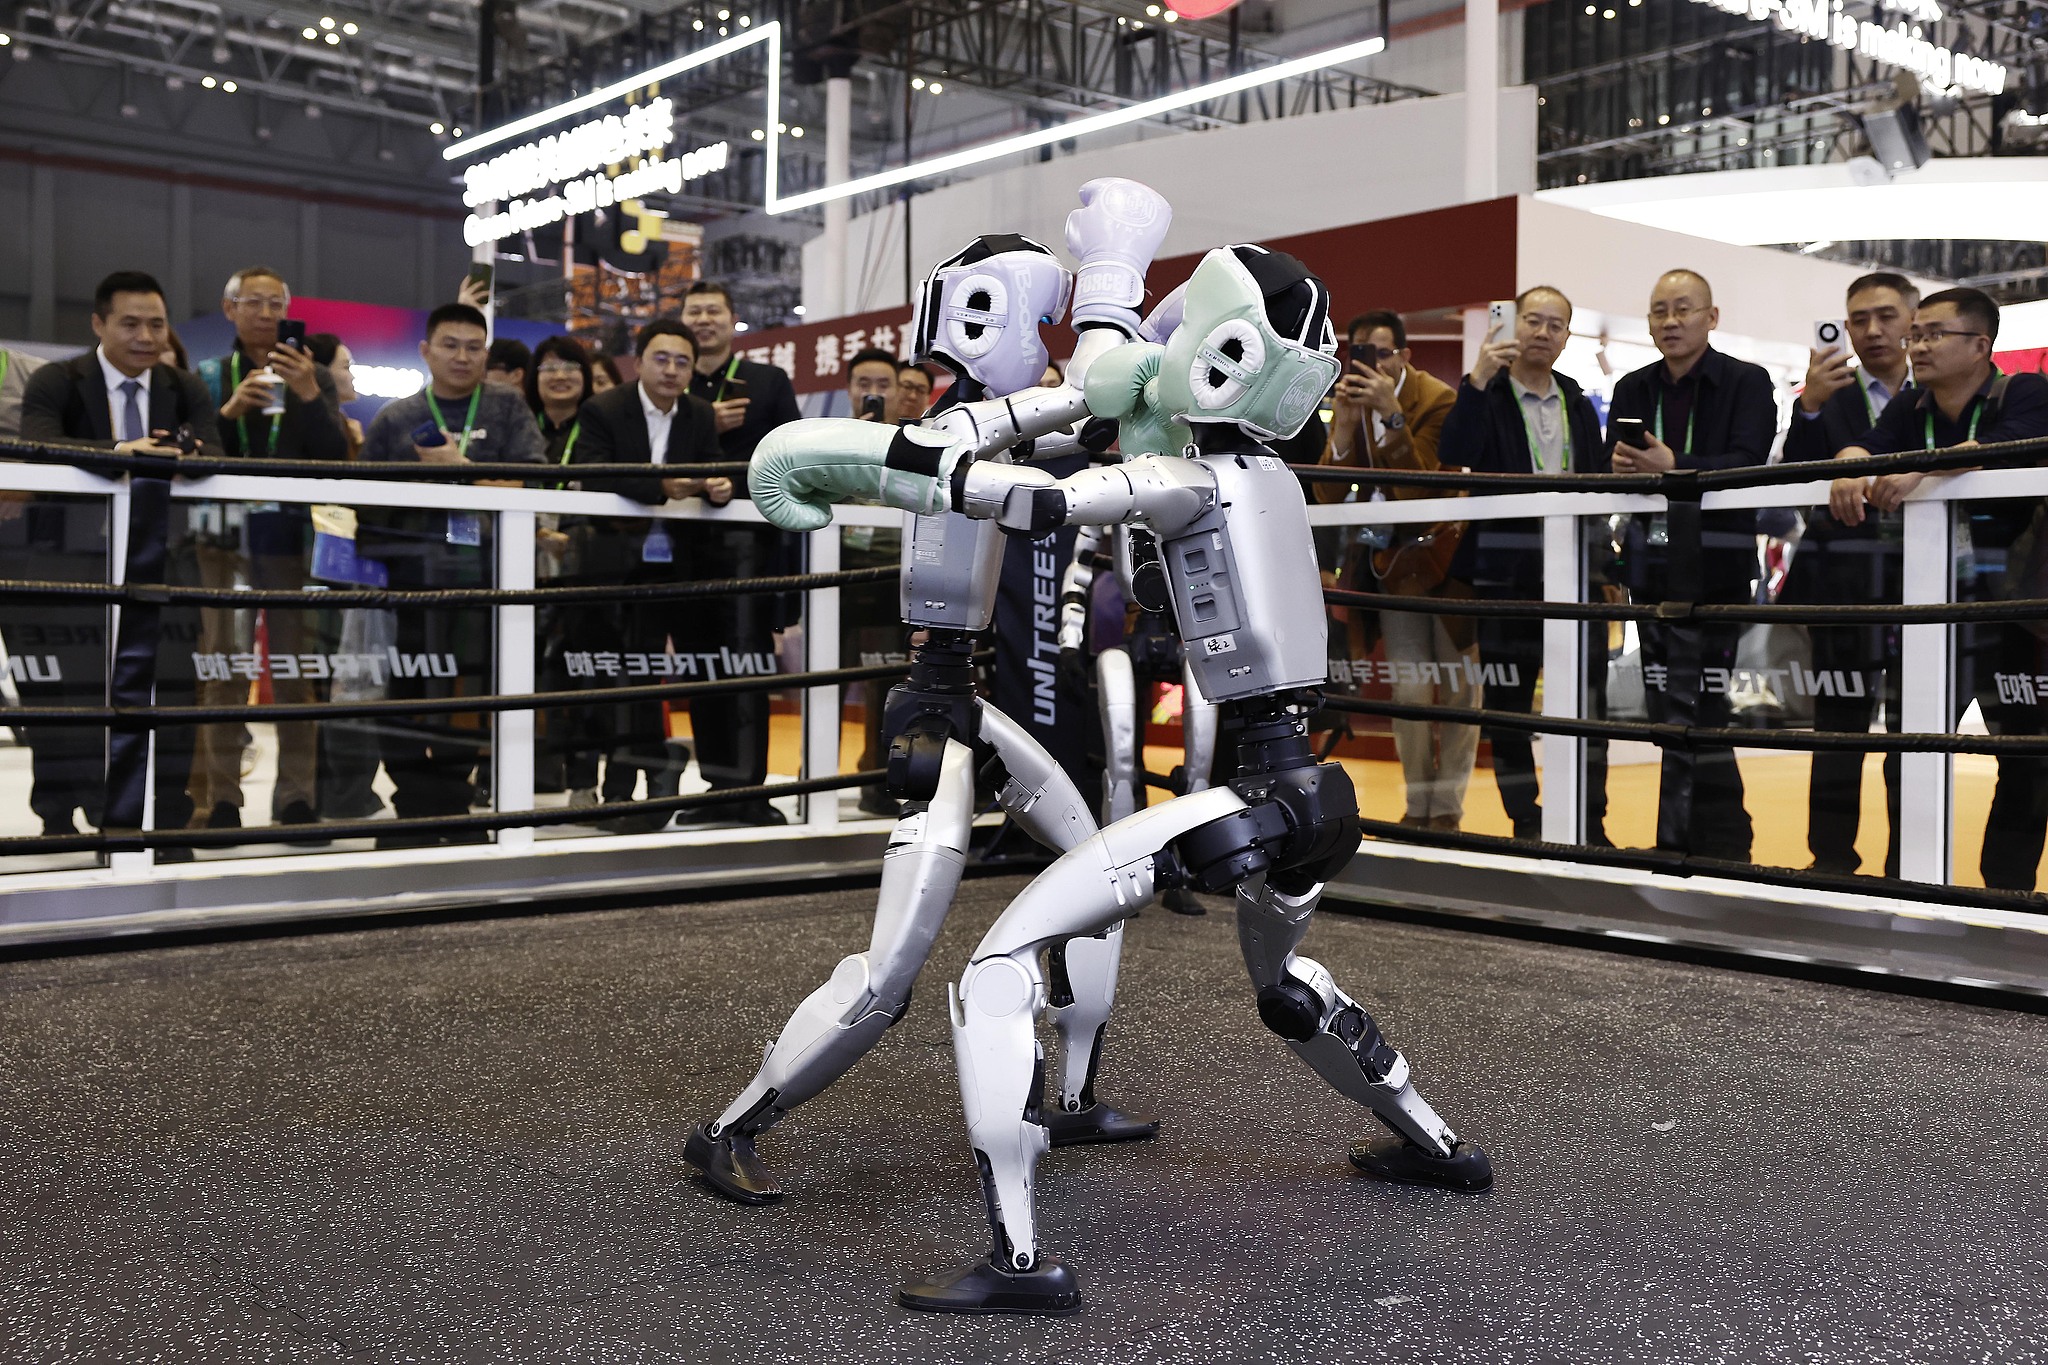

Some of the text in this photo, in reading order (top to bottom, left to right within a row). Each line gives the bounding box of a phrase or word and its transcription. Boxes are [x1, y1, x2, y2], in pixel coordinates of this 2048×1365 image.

[1860, 21, 1951, 88] making
[1954, 53, 2007, 95] now
[1015, 266, 1040, 366] BOOM!
[1077, 272, 1124, 298] FORCE
[1027, 550, 1062, 726] UNITREE
